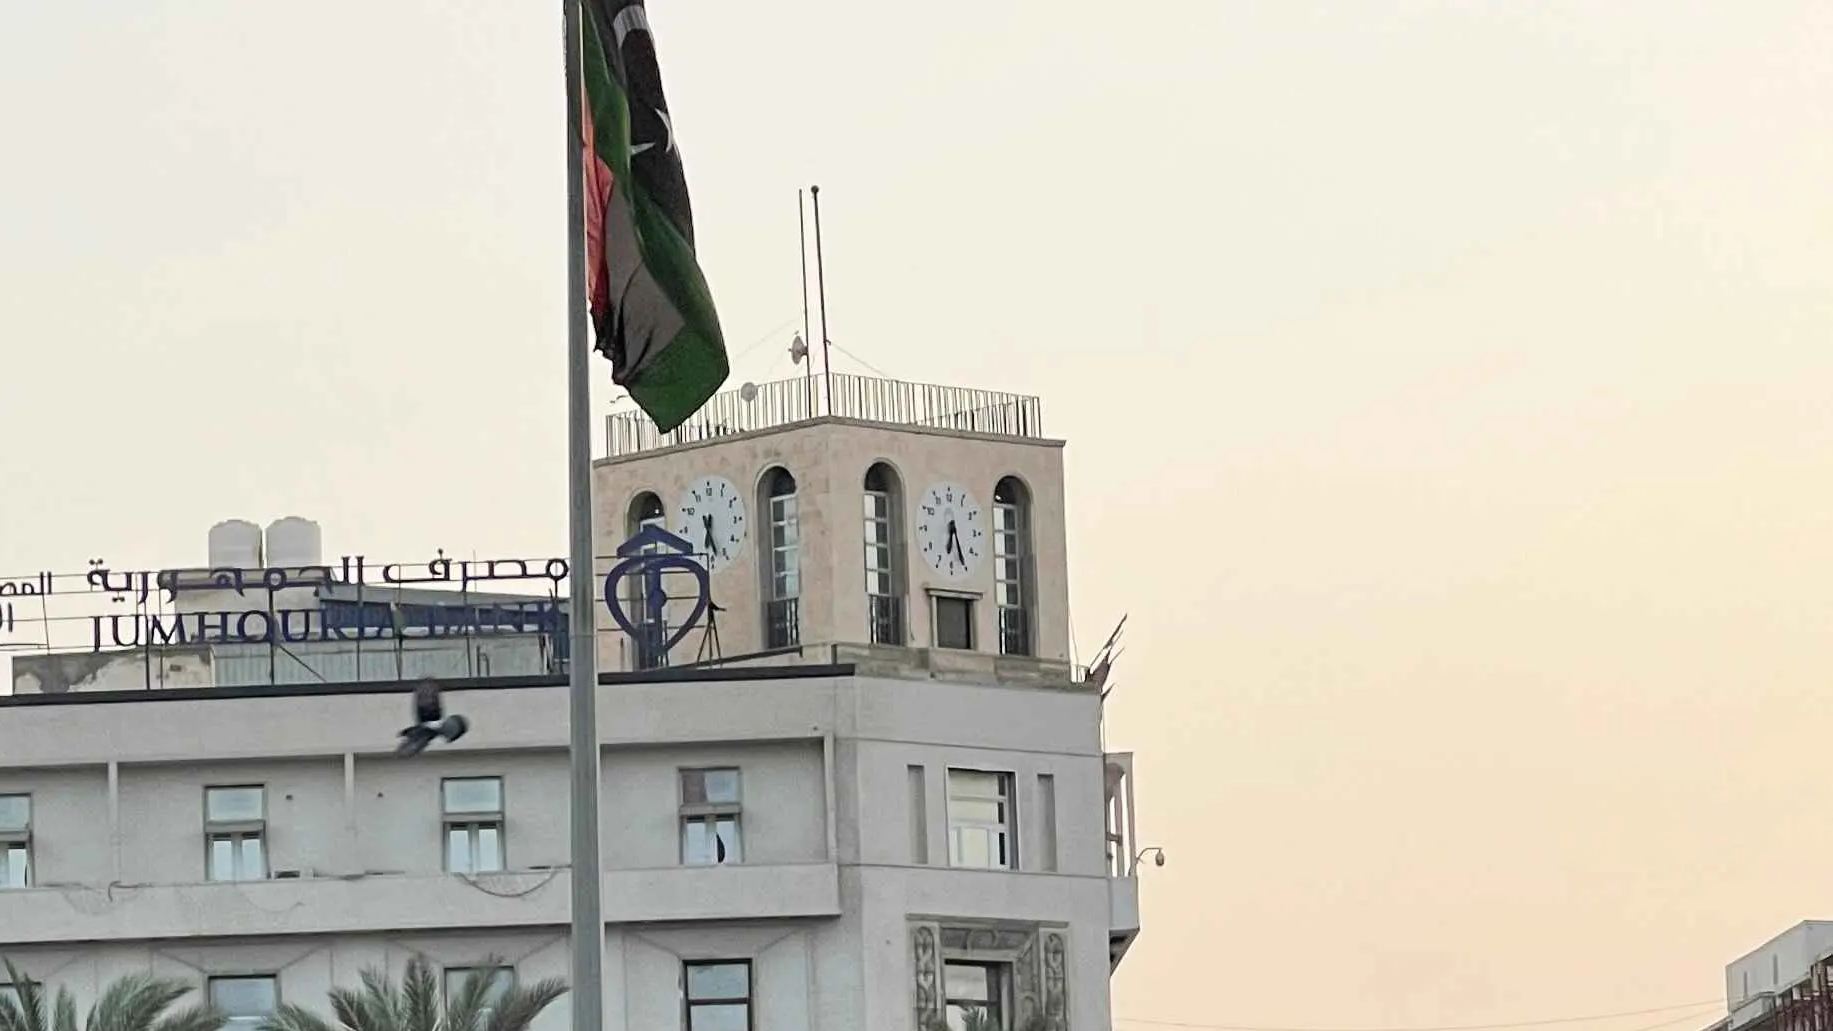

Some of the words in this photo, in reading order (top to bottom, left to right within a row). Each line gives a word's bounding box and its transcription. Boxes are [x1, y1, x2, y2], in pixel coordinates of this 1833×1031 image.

[86, 555, 365, 605] الجمهورية
[383, 547, 569, 593] مصرف
[88, 598, 411, 653] JUMHOURIA
